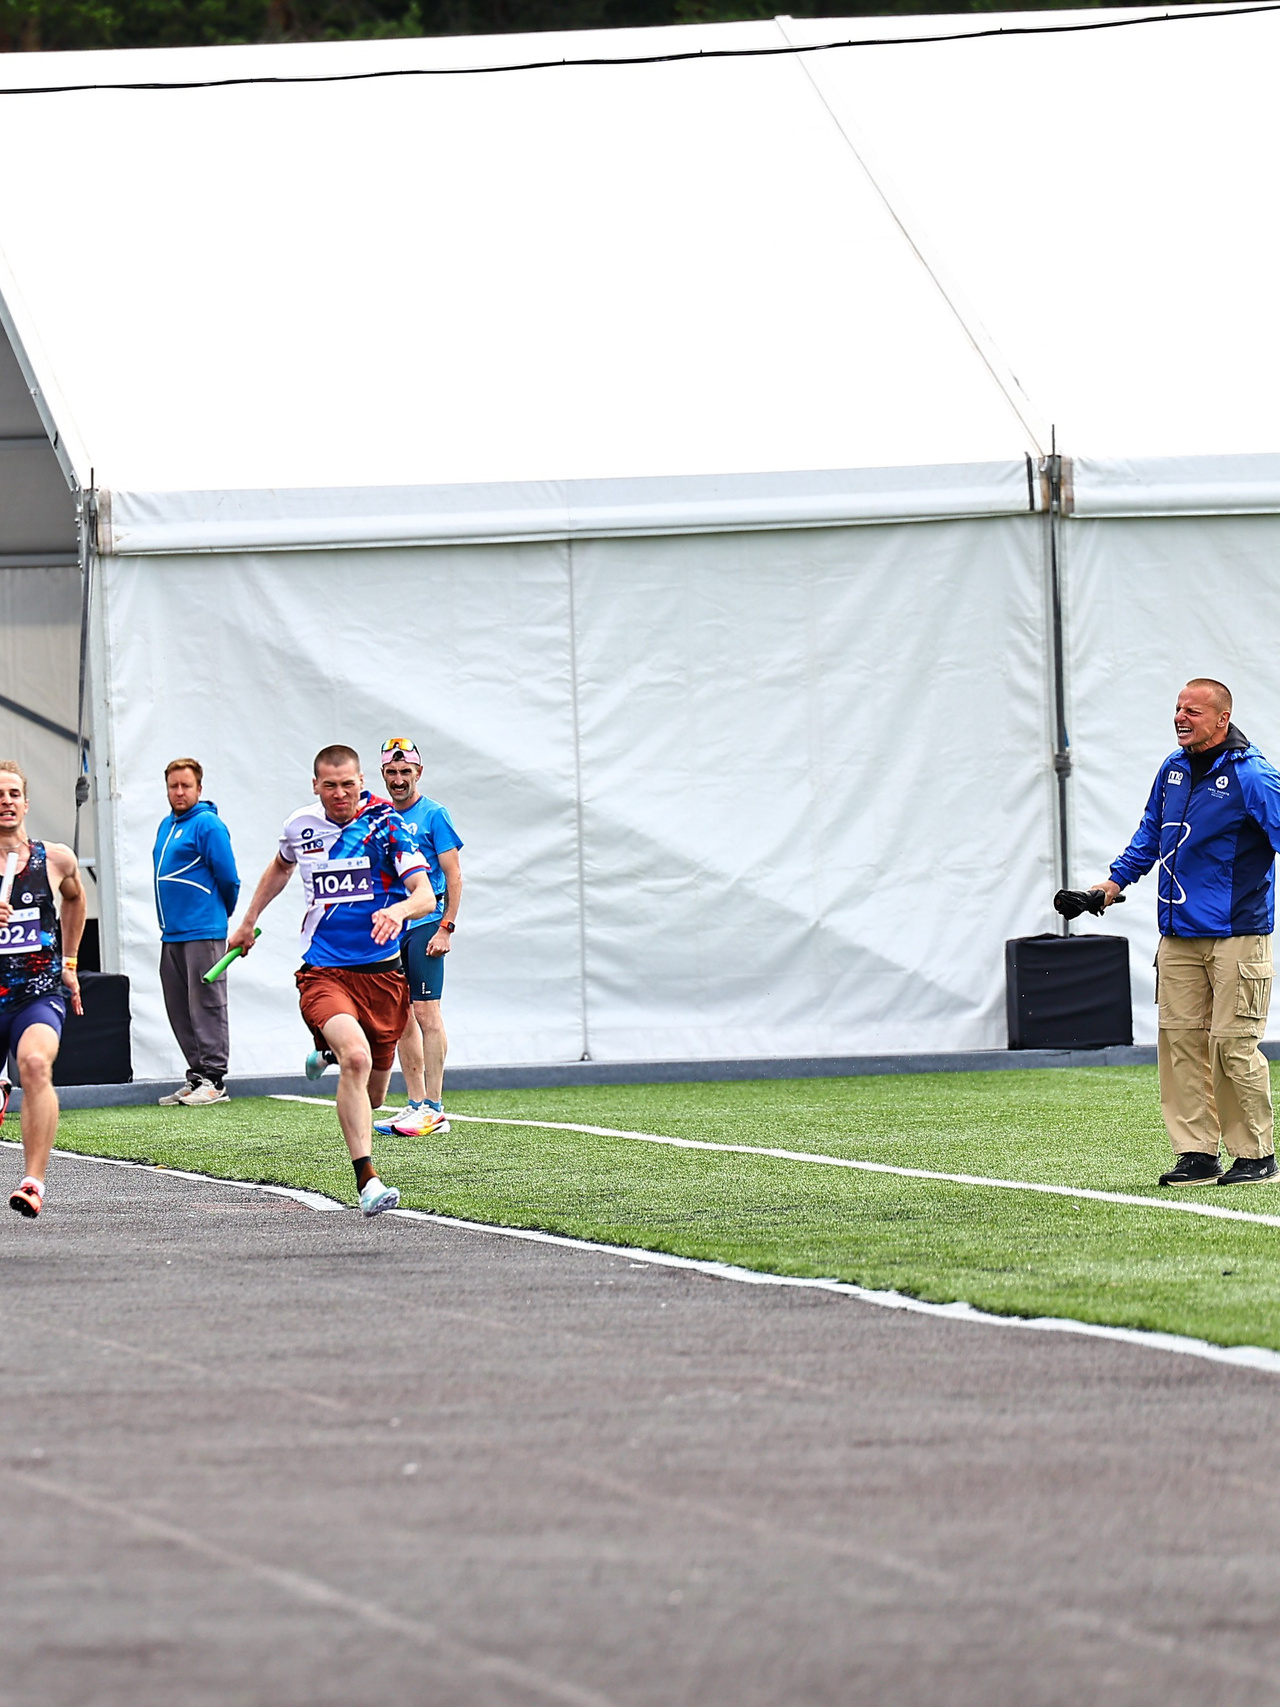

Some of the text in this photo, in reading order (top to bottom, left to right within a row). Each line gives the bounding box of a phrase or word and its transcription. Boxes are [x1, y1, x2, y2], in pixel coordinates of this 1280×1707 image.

[315, 874, 369, 895] 104 4
[27, 929, 38, 942] 4
